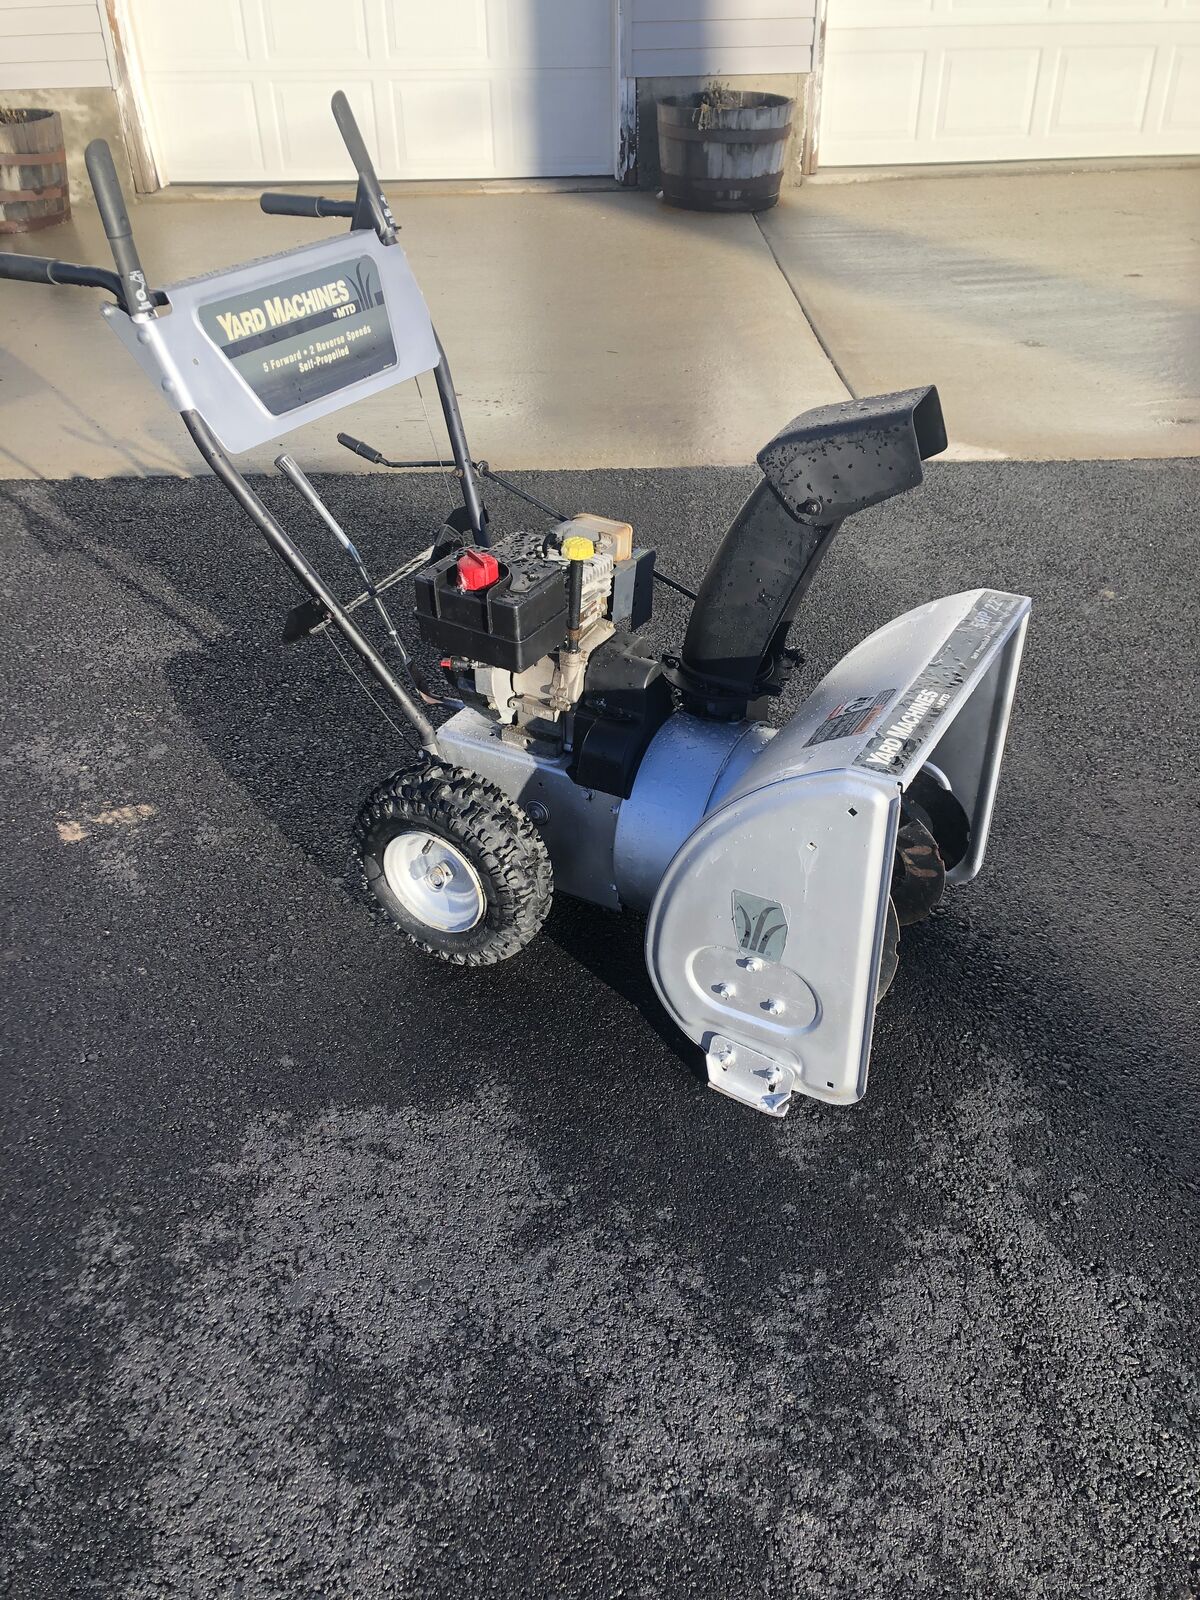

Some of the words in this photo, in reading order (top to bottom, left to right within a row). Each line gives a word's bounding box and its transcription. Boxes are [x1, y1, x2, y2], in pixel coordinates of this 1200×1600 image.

[336, 303, 356, 319] MTD
[262, 362, 269, 373] 5
[270, 349, 302, 370] Forward
[308, 344, 315, 355] 2
[315, 335, 346, 353] Reverse
[345, 324, 372, 341] Speeds
[298, 344, 350, 373] Self-Propelled
